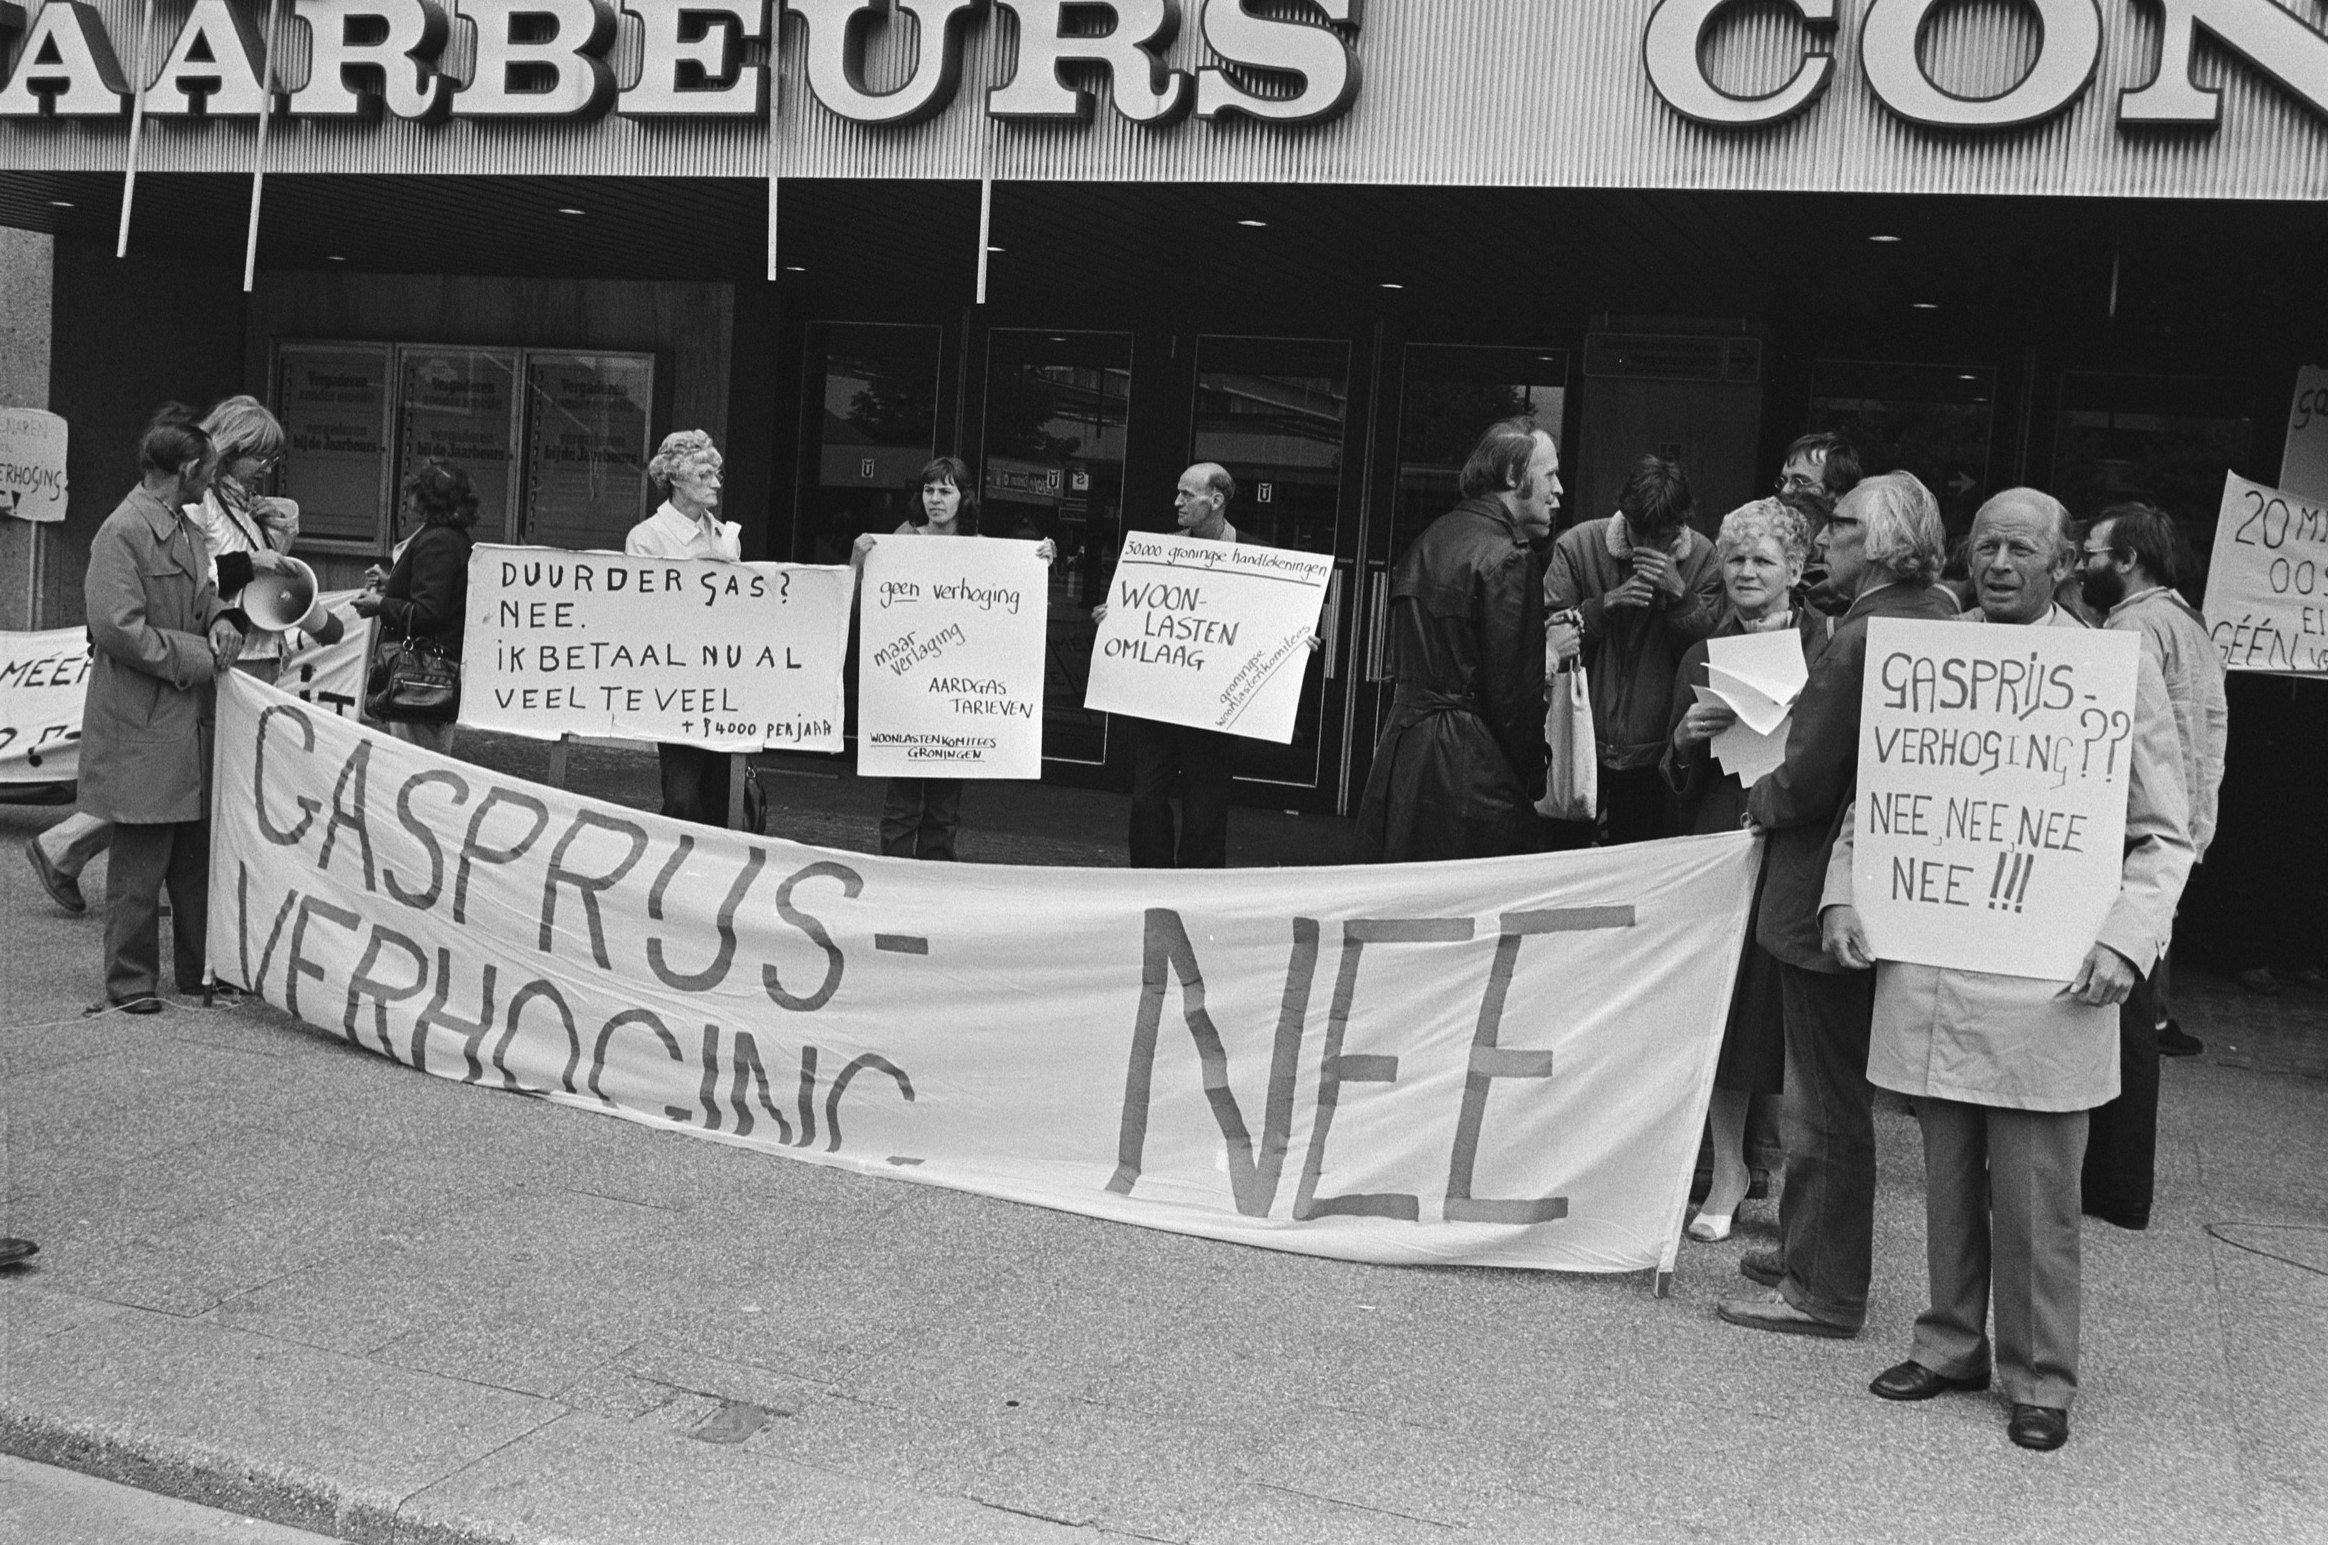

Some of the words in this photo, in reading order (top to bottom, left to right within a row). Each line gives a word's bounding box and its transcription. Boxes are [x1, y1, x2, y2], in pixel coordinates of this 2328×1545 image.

[2234, 490, 2290, 549] 20
[1168, 548, 1228, 568] groningse
[1232, 547, 1327, 581] handtekeningen
[501, 561, 683, 593] DUURDER
[700, 570, 791, 607] GAS?
[880, 580, 920, 609] geen
[933, 577, 1020, 615] verhoging
[1121, 579, 1207, 612] WOON-
[499, 600, 587, 629] NEE.
[1144, 610, 1240, 647] LASTEN
[538, 642, 687, 673] BETAAL
[702, 645, 742, 668] NU
[756, 646, 803, 670] AL
[873, 631, 916, 667] maar
[890, 622, 966, 676] verlaging
[1104, 637, 1205, 672] OMLAAG
[928, 677, 1007, 695] AARDGAS
[1219, 650, 1265, 704] groningse
[495, 686, 587, 710] VEEL
[600, 686, 644, 712] TE
[655, 687, 739, 714] VEEL
[949, 698, 1034, 719] TARIEVEN
[907, 748, 982, 761] GRONINGEN
[1891, 855, 1975, 907] NEE
[1105, 904, 1636, 1224] NEE
